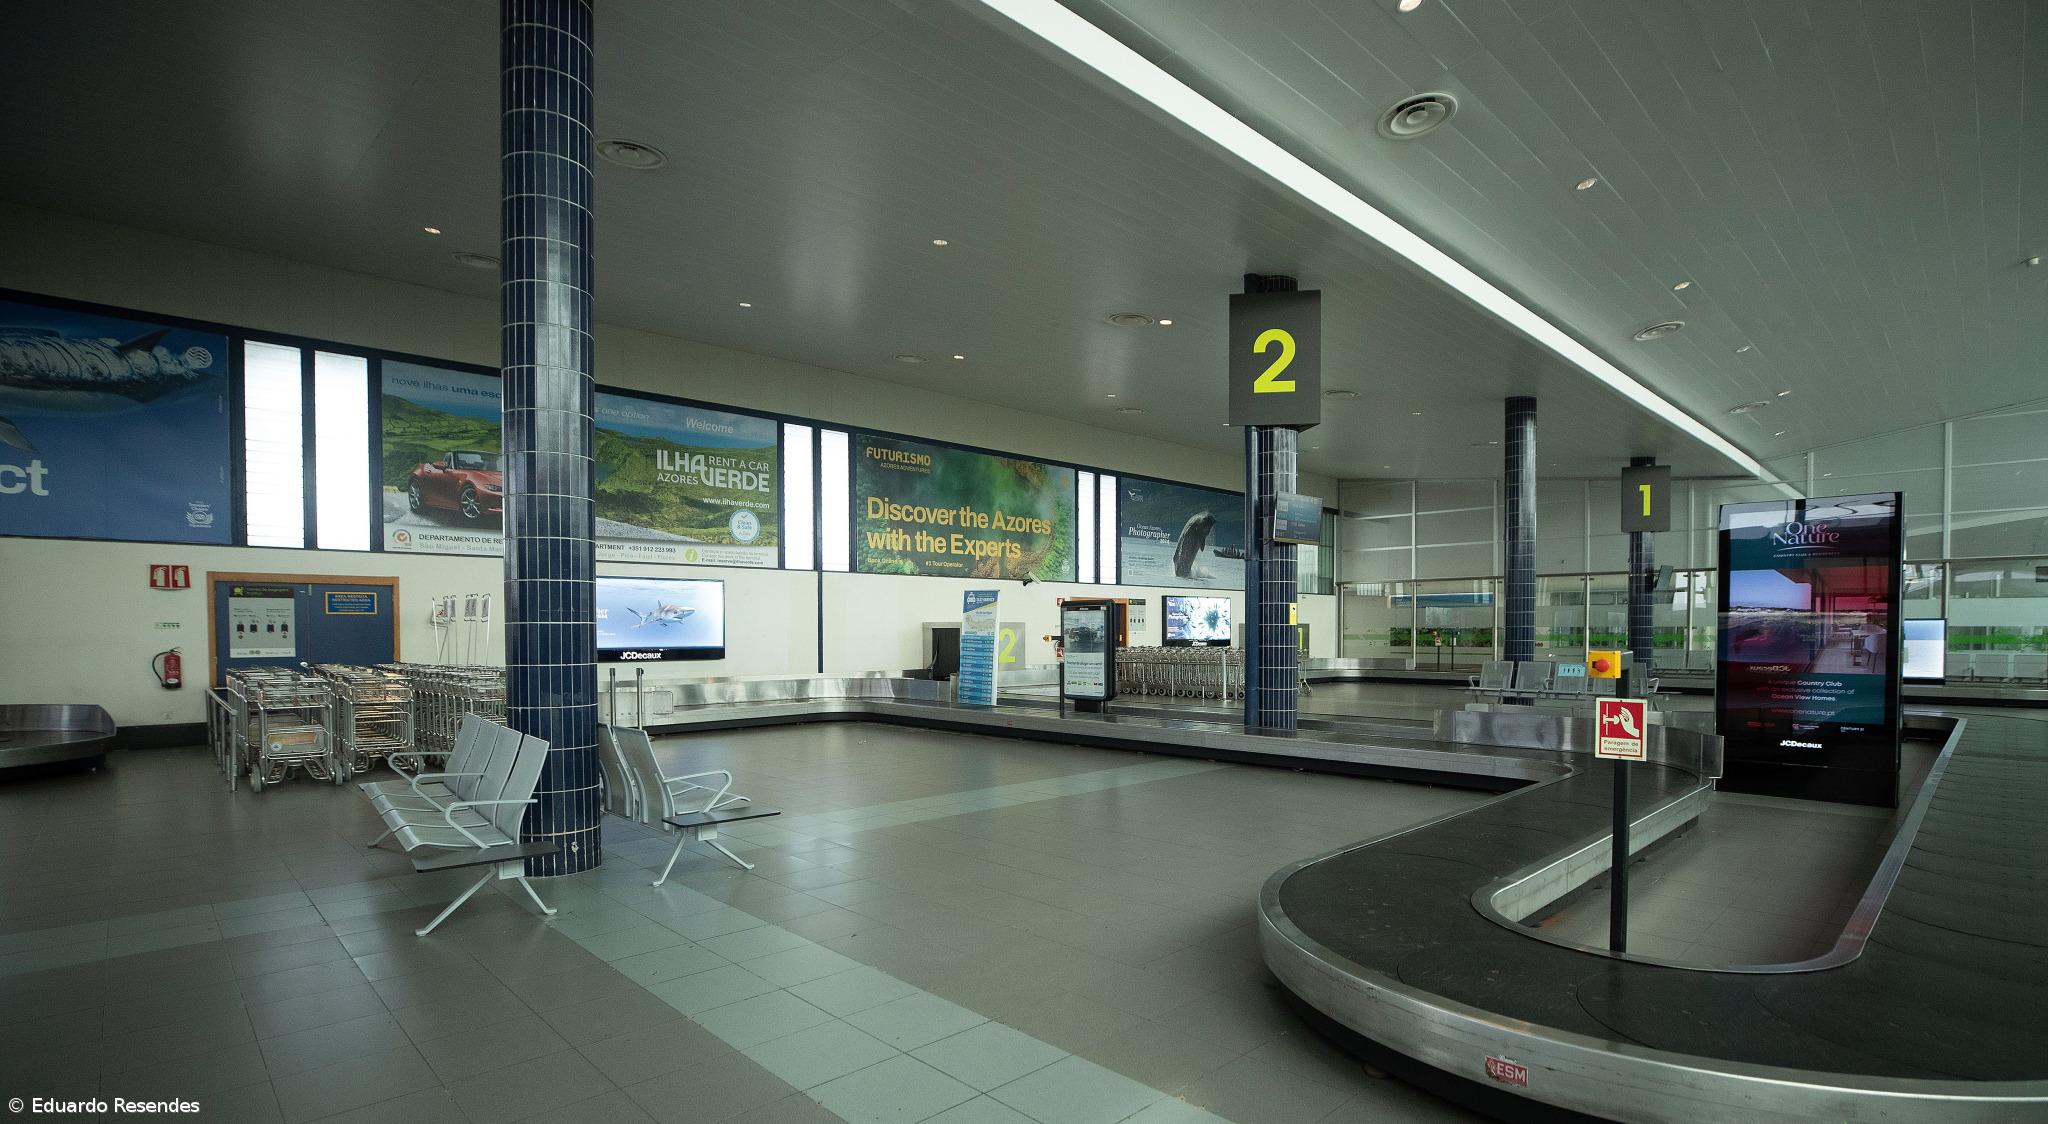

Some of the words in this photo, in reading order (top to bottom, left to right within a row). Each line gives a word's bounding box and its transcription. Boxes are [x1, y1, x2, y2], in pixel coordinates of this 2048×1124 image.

[1253, 328, 1297, 393] 2
[391, 376, 420, 387] nove
[423, 381, 449, 391] ilhas
[451, 385, 479, 396] uma
[621, 410, 651, 421] option
[686, 417, 734, 434] Welcome
[656, 449, 705, 474] ILHA
[709, 456, 737, 469] RENT
[739, 459, 747, 469] A
[748, 460, 769, 472] CAR
[866, 447, 931, 466] FUTURISMO
[0, 459, 49, 497] ct
[657, 472, 698, 485] AZORES
[700, 466, 770, 493] VERDE
[702, 497, 770, 509] www.ilhaverde.com
[1639, 484, 1651, 517] 1
[867, 496, 957, 526] Discover
[959, 506, 989, 529] the
[992, 511, 1051, 535] Azores
[1129, 526, 1171, 539] Photographer
[1786, 521, 1828, 535] One
[419, 533, 480, 543] DEPARTAMENTO
[867, 527, 911, 552] with
[915, 530, 947, 554] the
[951, 534, 1021, 560] Experts
[1773, 531, 1840, 546] Nature
[595, 543, 625, 551] ARTMENT
[999, 627, 1016, 663] 2
[620, 651, 662, 660] JCDecaux
[1603, 739, 1629, 747] Paragem
[1780, 740, 1823, 749] JCDecaux
[1496, 1063, 1526, 1082] ESM
